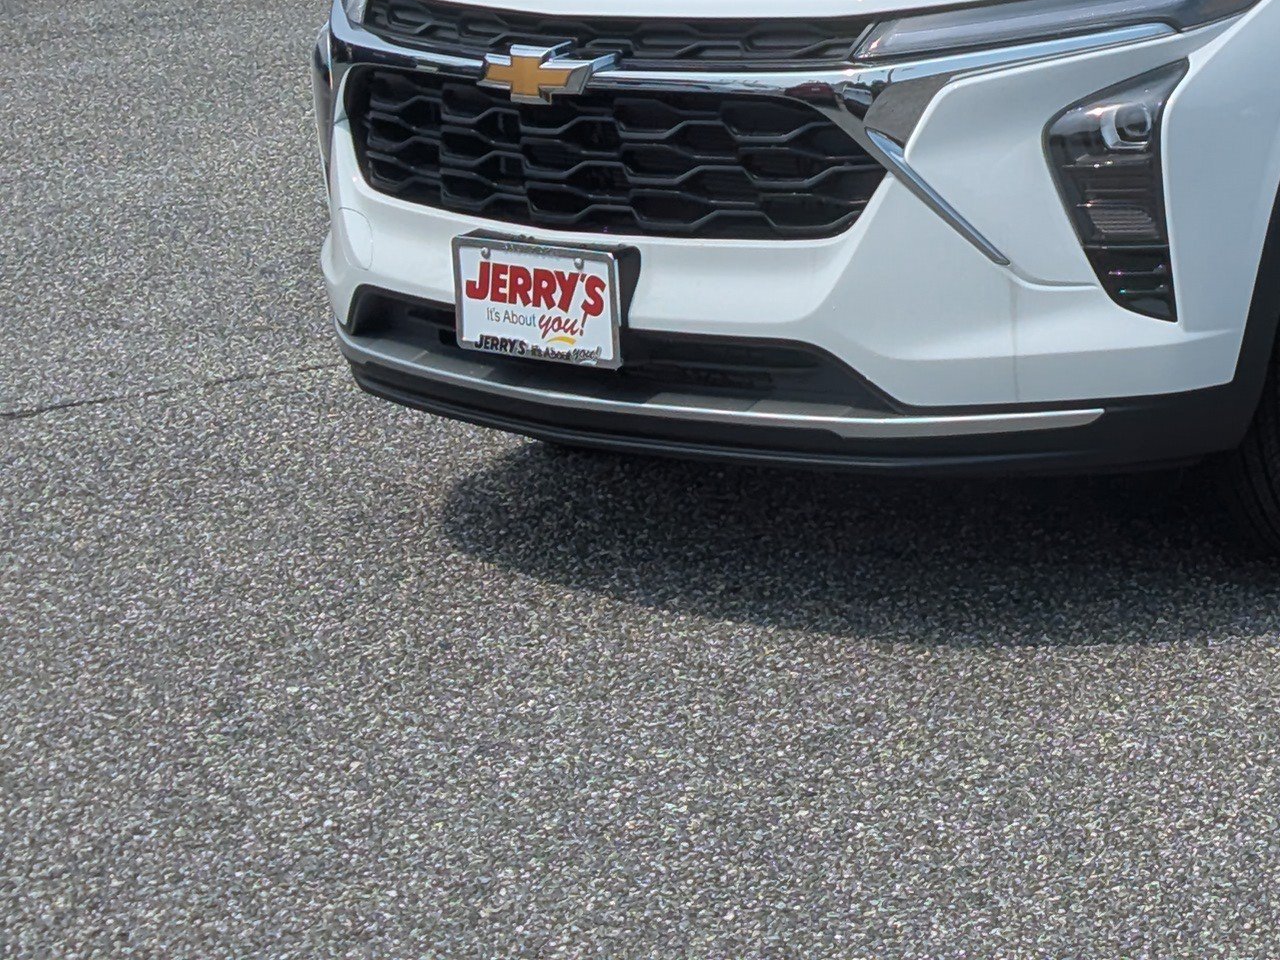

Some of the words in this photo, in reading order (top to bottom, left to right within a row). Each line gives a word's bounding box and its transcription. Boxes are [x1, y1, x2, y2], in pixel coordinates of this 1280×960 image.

[465, 261, 607, 317] JERRY'S
[486, 307, 501, 322] It's
[503, 309, 537, 327] About
[538, 311, 587, 339] you!
[474, 334, 528, 355] JERRY'S
